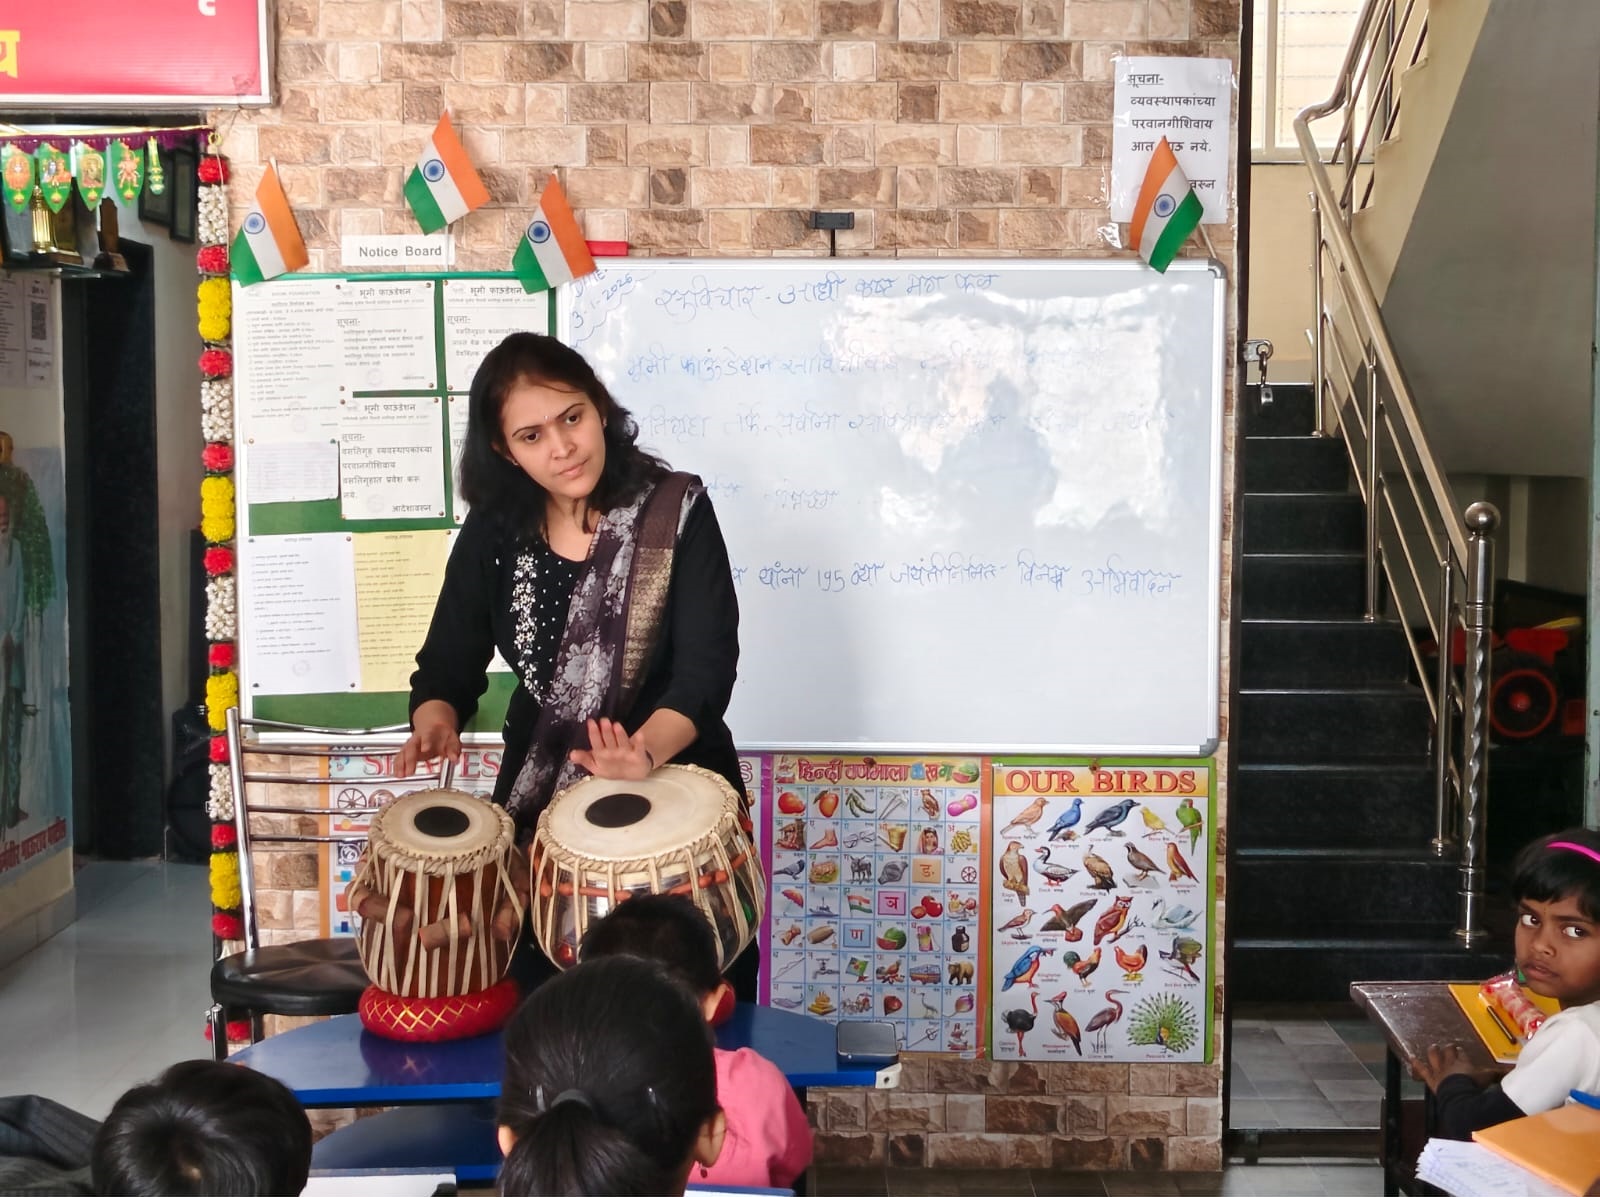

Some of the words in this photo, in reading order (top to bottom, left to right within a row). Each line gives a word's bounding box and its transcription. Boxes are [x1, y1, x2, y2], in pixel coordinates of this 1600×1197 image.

[1128, 74, 1164, 88] सूचना-
[1130, 93, 1216, 107] व्यवस्थापकांच्या
[1131, 115, 1214, 130] परवानगीशिवाय
[1131, 141, 1155, 152] आत
[1167, 141, 1185, 152] ाऊ
[358, 245, 399, 258] Notice
[405, 245, 443, 258] Board
[363, 751, 502, 779] SES
[797, 757, 844, 785] हिन्दी
[1005, 769, 1080, 793] OUR
[1092, 769, 1197, 793] BIRDS
